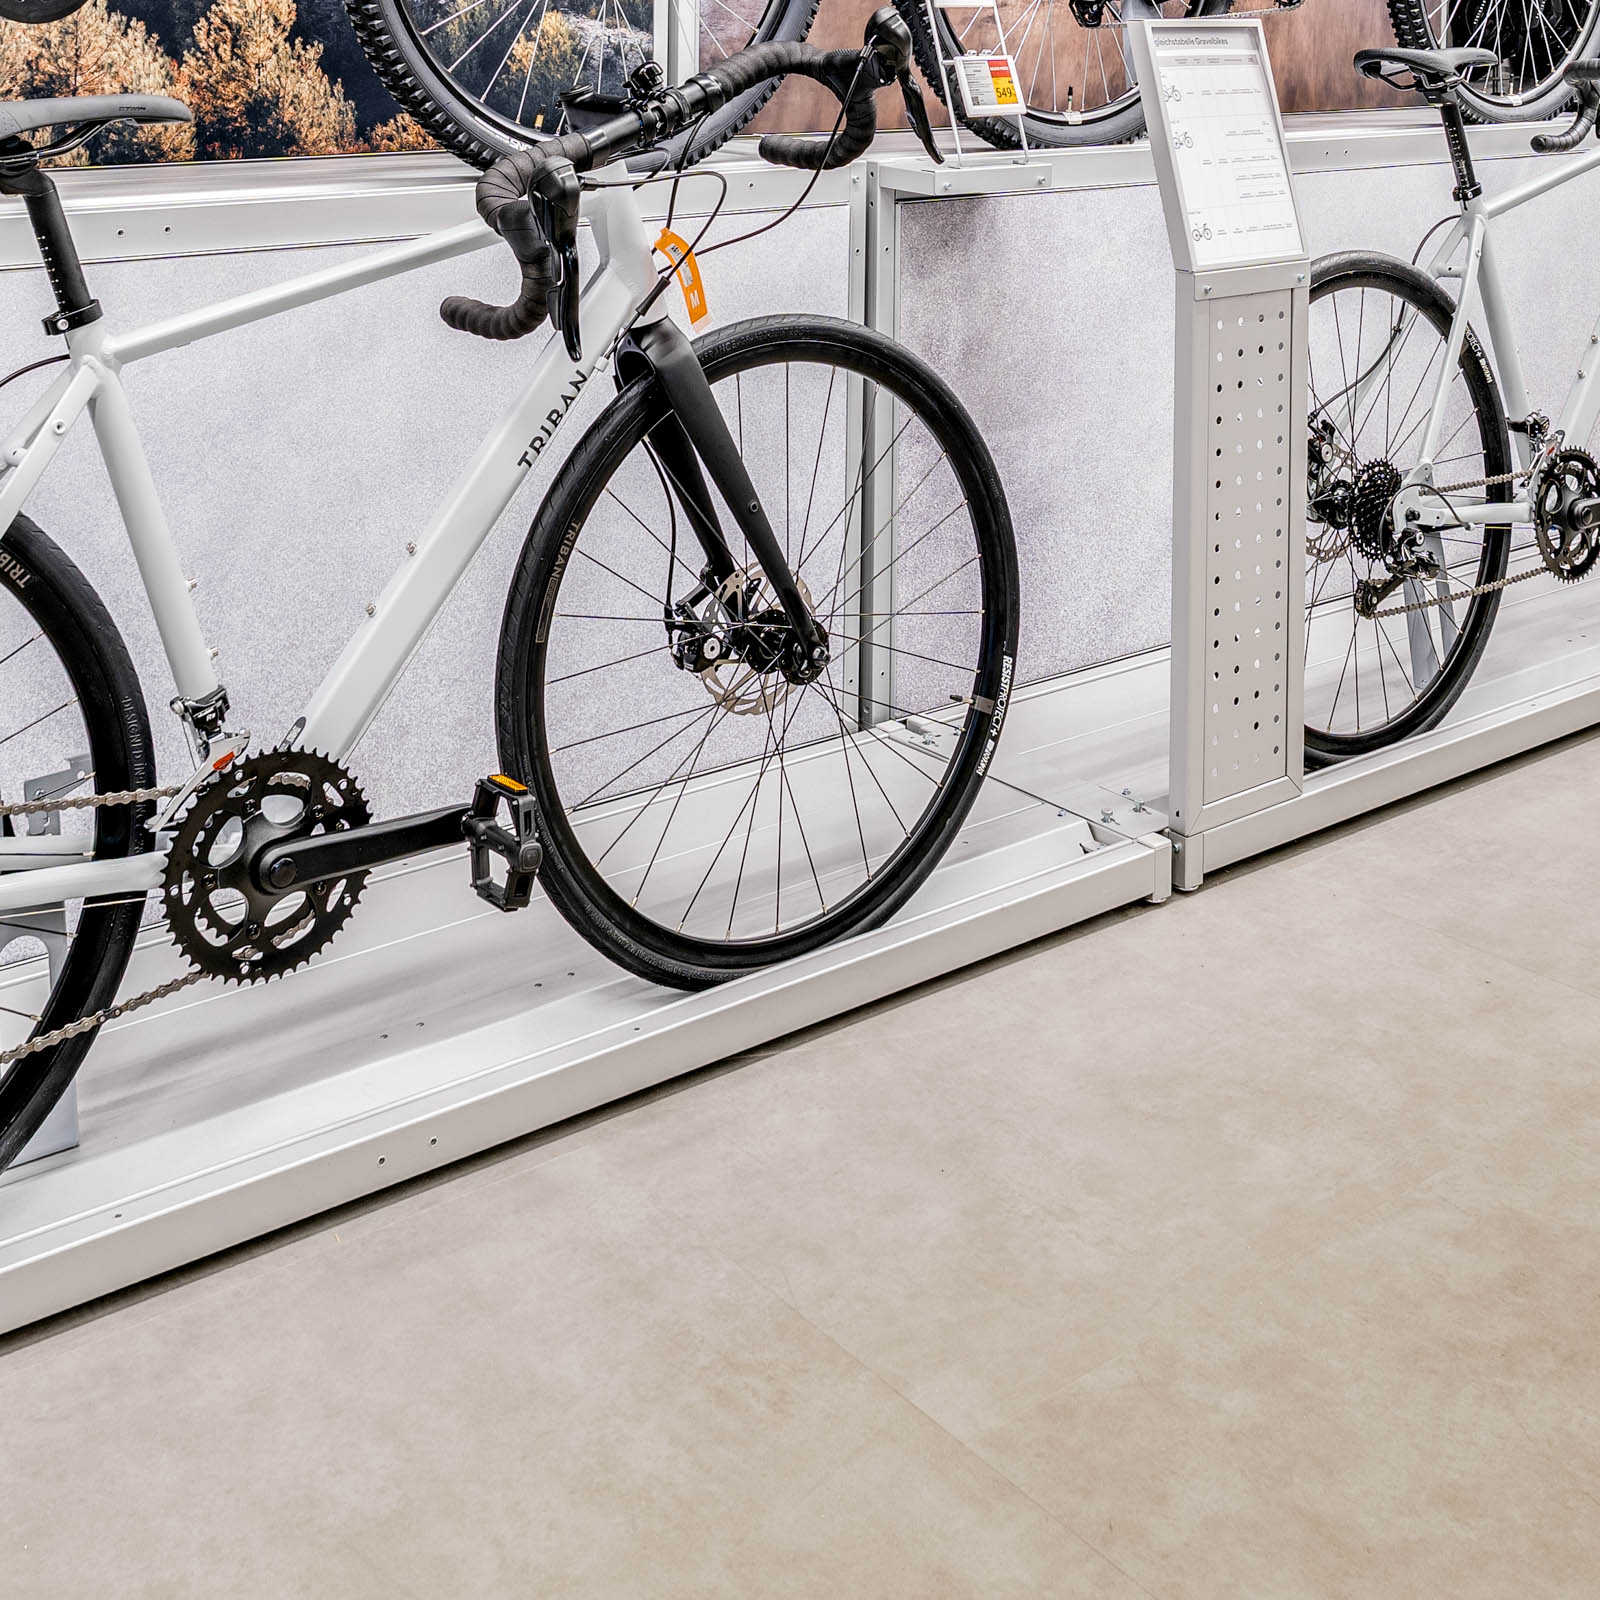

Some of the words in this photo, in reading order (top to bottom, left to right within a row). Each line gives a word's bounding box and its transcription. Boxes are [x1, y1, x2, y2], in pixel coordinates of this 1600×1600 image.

[996, 86, 1012, 98] 549
[517, 369, 588, 468] TRIBAN
[551, 521, 581, 579] TRIBAN
[990, 655, 1013, 738] RESISTPROTECT+
